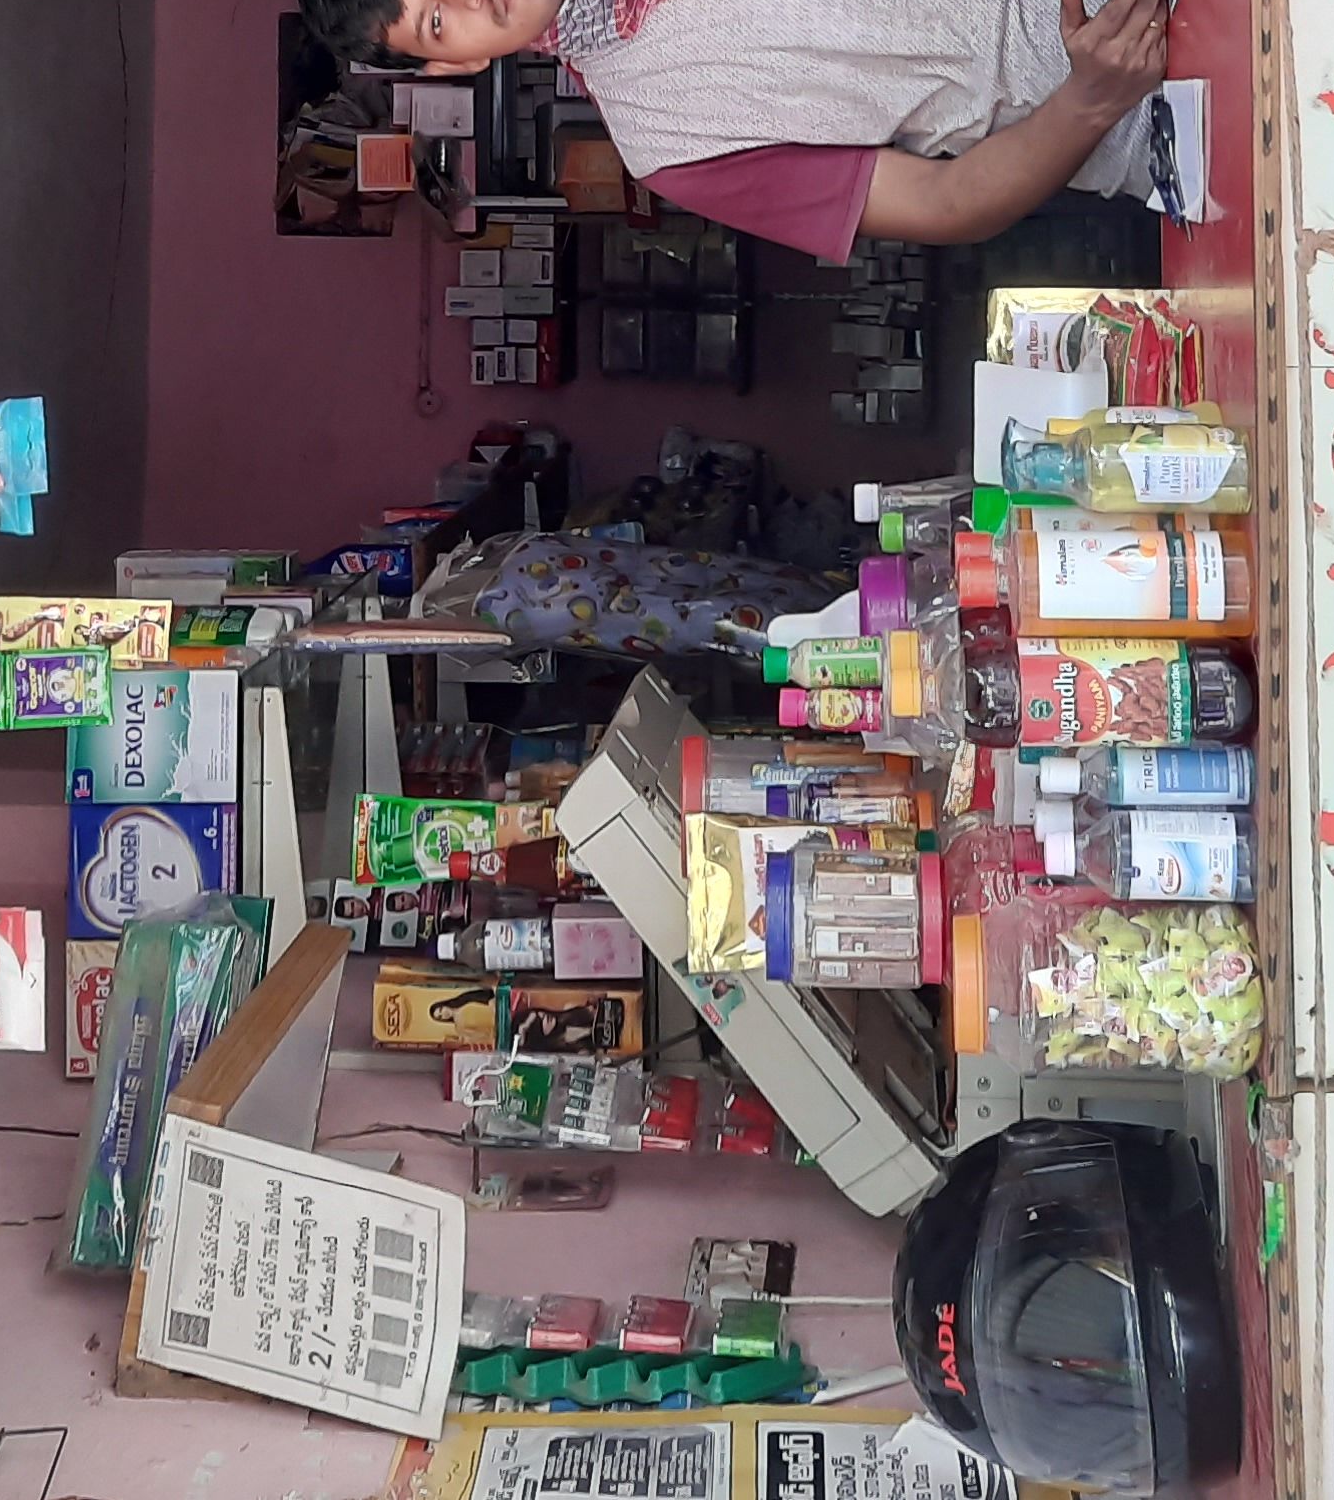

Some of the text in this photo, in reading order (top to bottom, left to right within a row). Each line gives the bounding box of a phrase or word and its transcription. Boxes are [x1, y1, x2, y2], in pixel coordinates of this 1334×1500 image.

[1053, 661, 1081, 743] Sugandha
[1088, 679, 1107, 733] PANIYAM
[124, 683, 146, 788] DEXOLAC
[203, 826, 217, 838] 6
[435, 826, 450, 864] Dettol
[151, 863, 176, 881] 2
[386, 993, 400, 1037] SESA
[308, 1351, 332, 1368] 2
[934, 1301, 967, 1396] JADE
